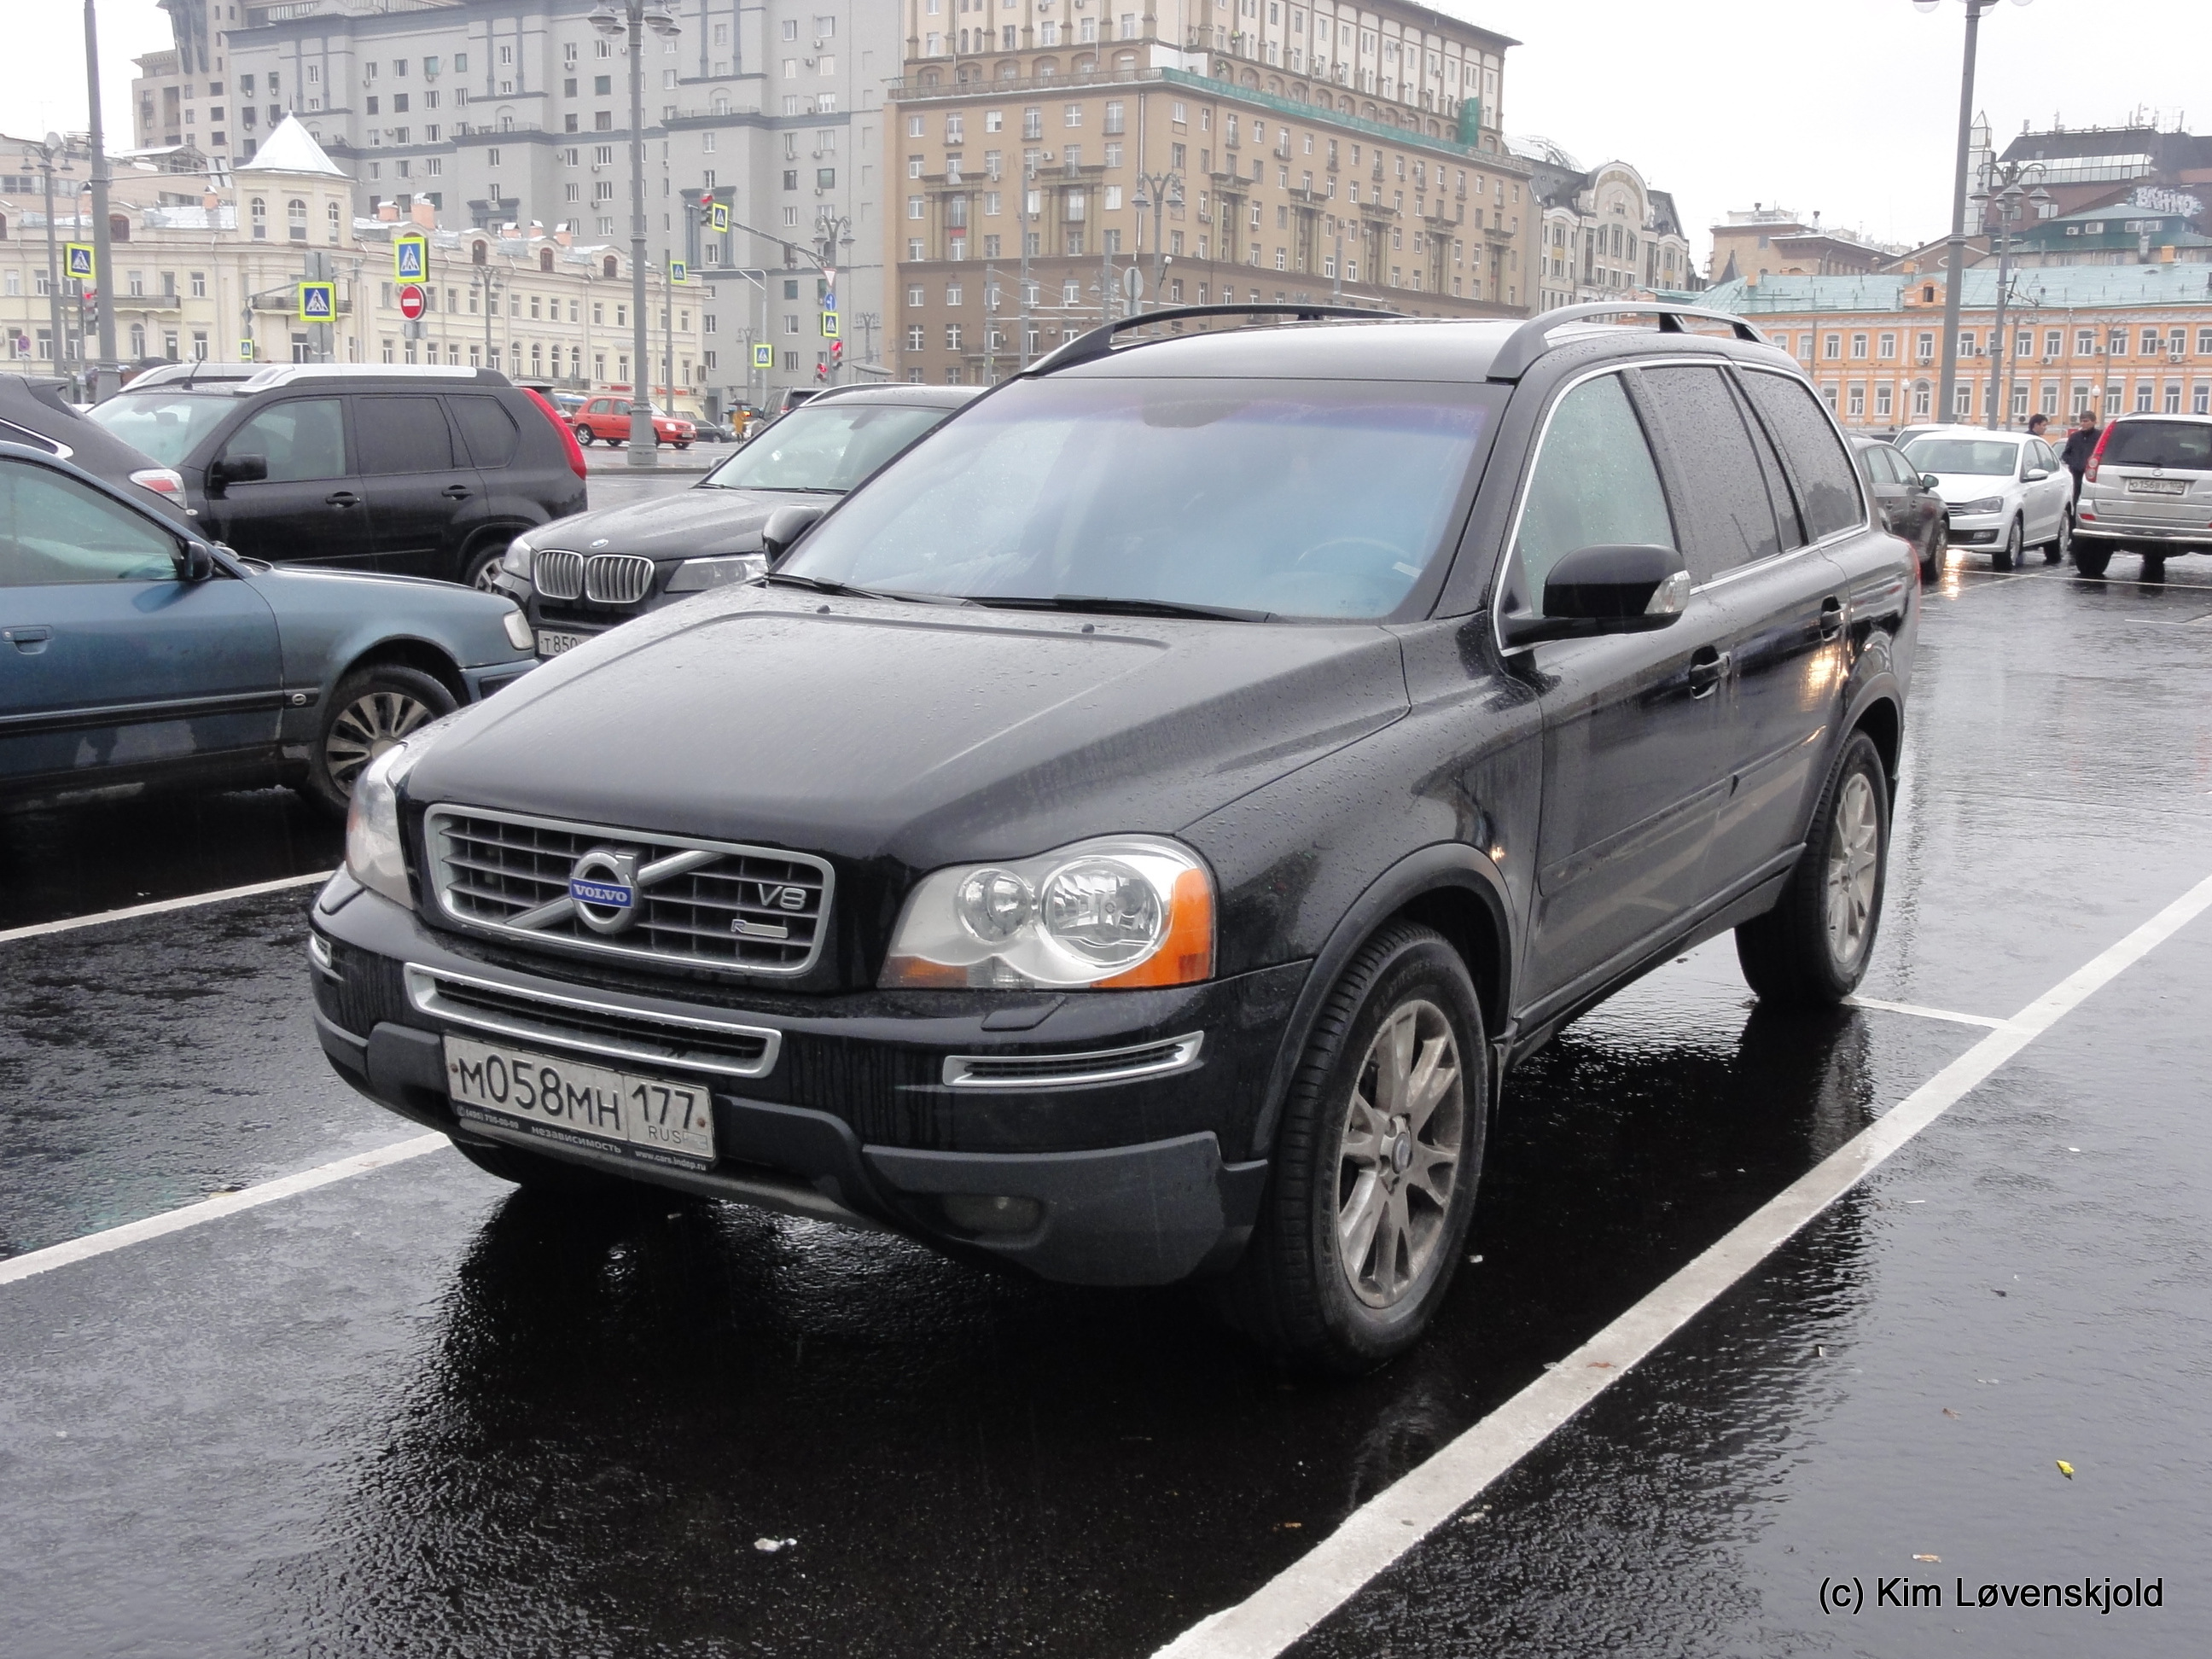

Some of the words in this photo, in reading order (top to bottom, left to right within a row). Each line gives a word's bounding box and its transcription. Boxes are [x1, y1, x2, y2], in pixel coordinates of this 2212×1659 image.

[544, 635, 583, 653] Т850
[573, 883, 628, 902] VOLVO
[757, 883, 806, 911] V8
[632, 1084, 695, 1130] 177
[648, 1125, 682, 1144] RUS
